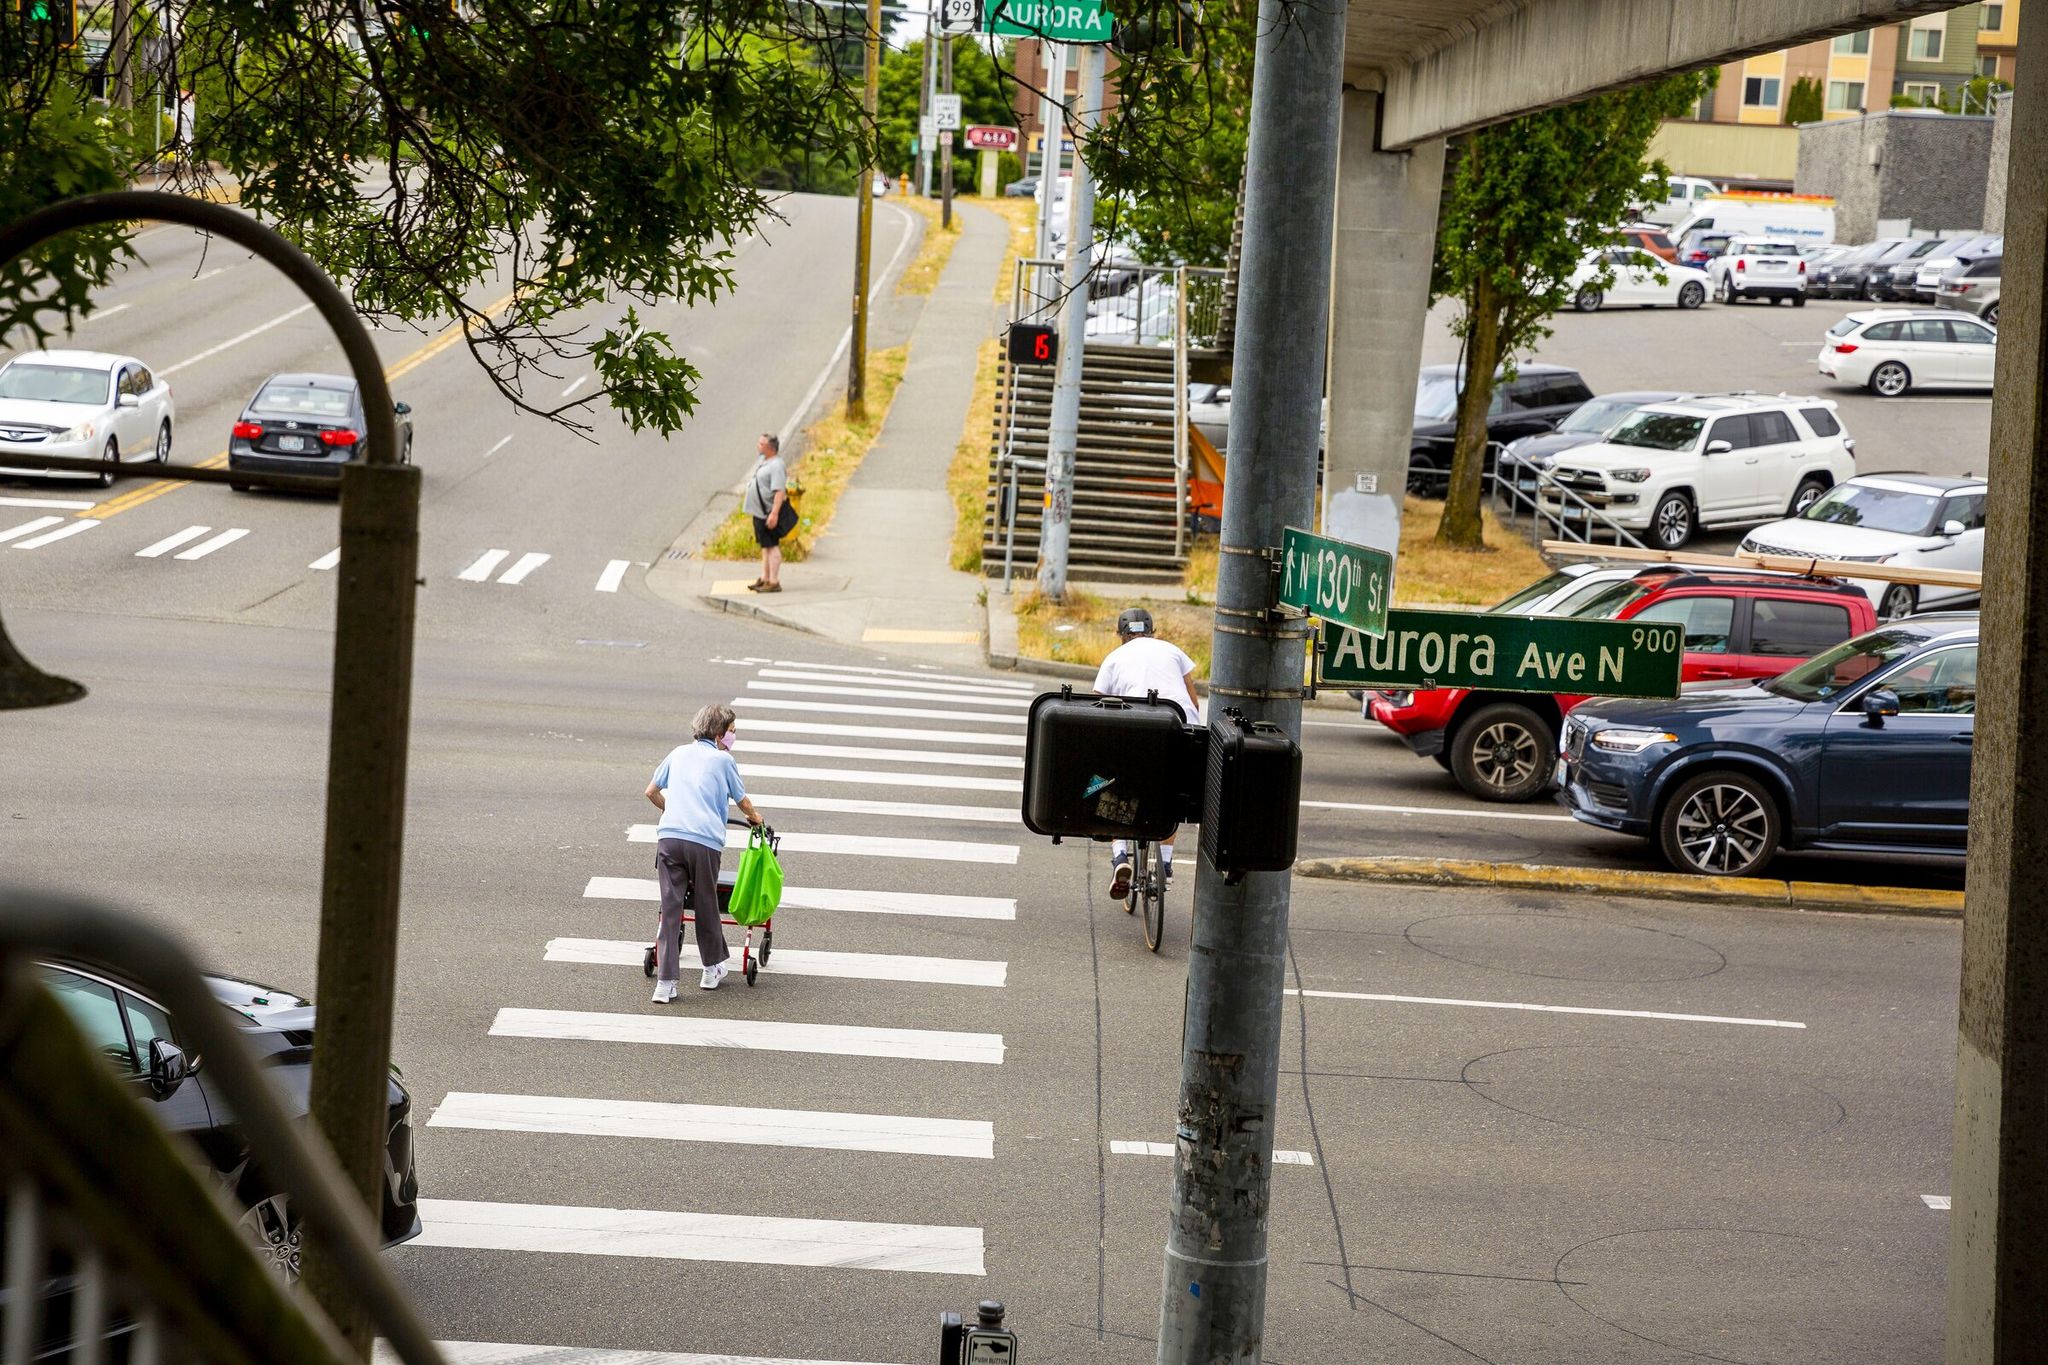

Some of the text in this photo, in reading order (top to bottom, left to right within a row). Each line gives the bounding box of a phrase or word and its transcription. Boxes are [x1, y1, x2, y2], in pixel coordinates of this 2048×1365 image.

[952, 1, 972, 16] 99
[999, 2, 1102, 30] AURORA
[937, 113, 956, 125] 25
[1299, 549, 1382, 614] N 130th St
[1332, 628, 1676, 682] Aurora Ave N 900
